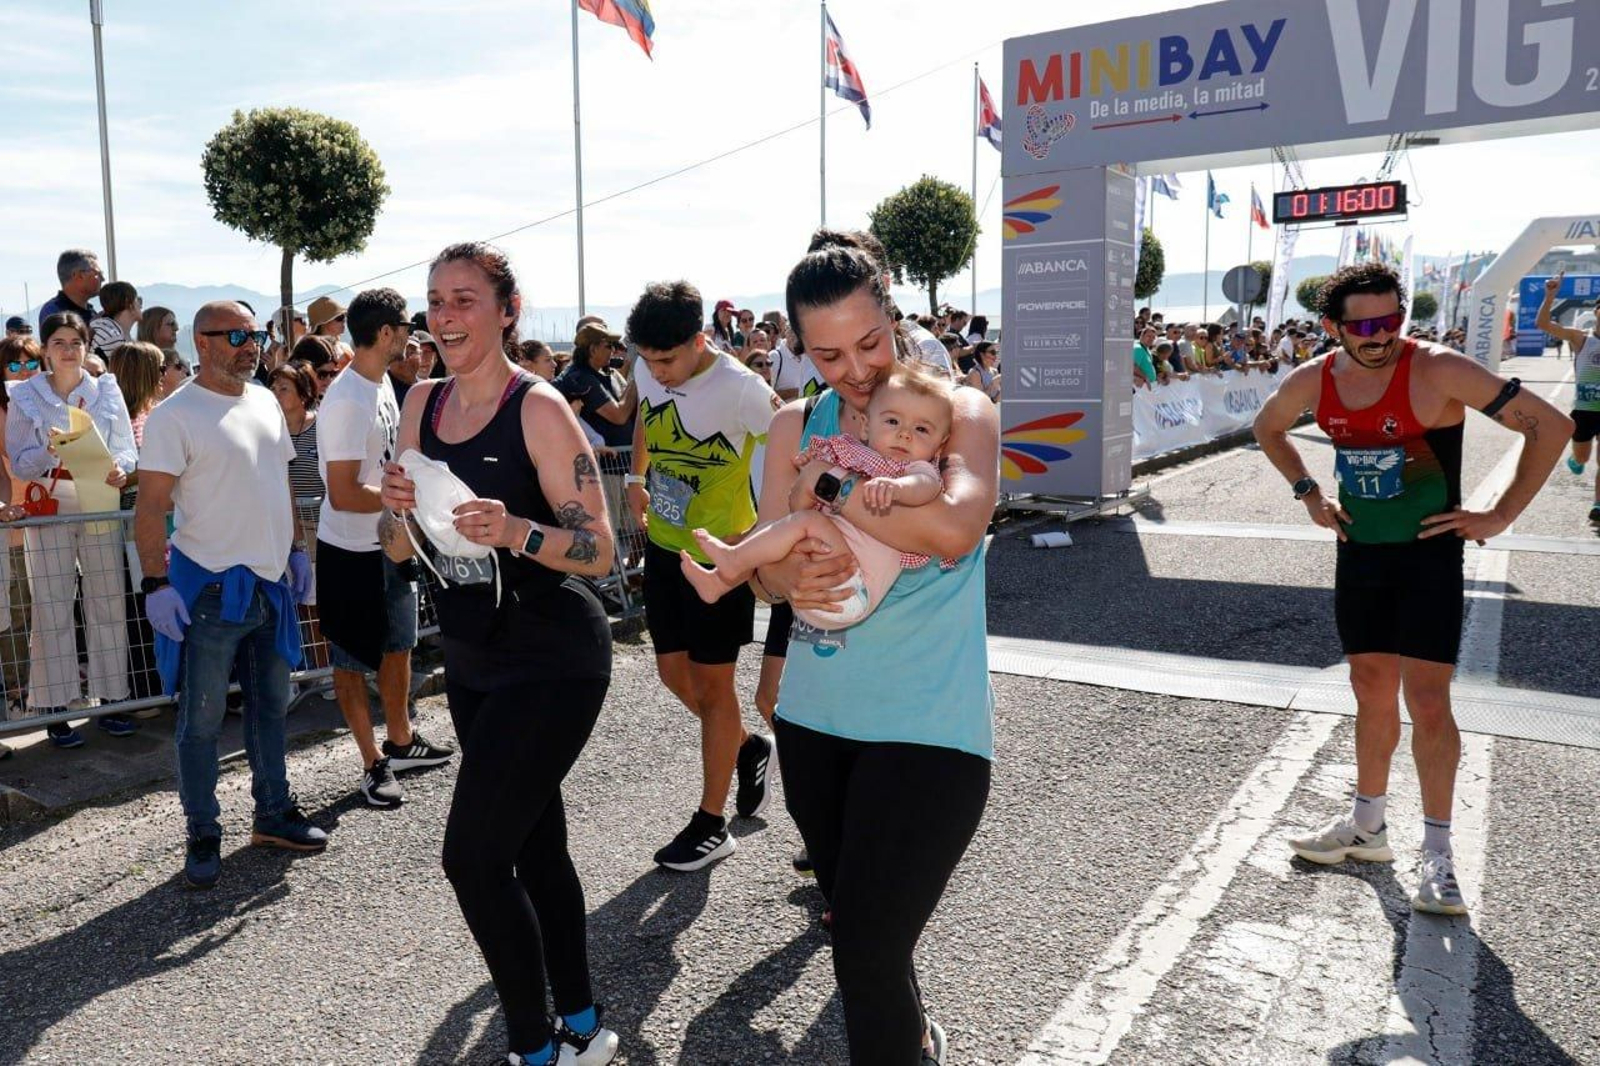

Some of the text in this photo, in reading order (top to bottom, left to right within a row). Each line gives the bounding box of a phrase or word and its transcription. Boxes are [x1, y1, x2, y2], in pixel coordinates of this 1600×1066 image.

[1017, 18, 1288, 106] MINIBAY
[1090, 78, 1265, 119] De la media, la mitad
[1044, 367, 1085, 377] DEPORTE
[1044, 377, 1081, 387] GALEGO
[1357, 475, 1380, 494] 11
